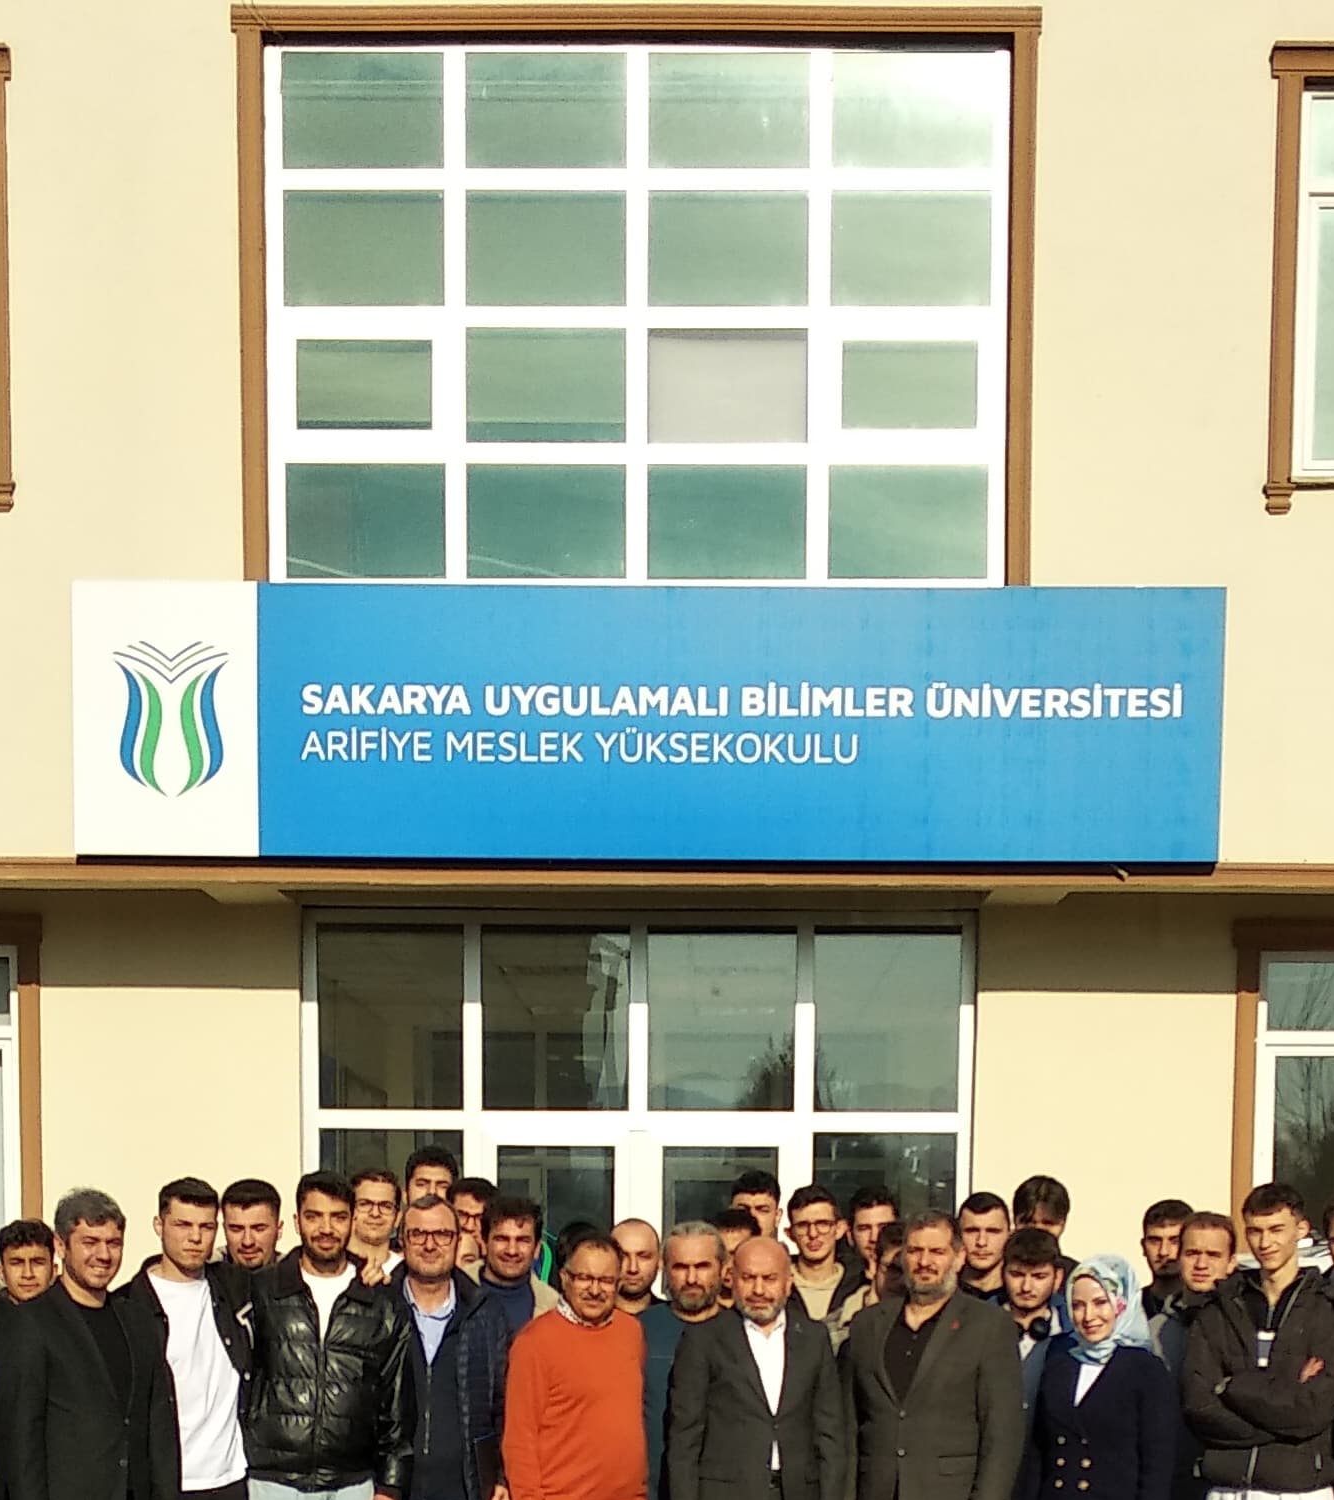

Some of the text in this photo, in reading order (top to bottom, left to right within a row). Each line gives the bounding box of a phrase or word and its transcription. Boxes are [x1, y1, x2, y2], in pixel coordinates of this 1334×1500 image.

[302, 681, 1183, 719] SAKARYA UYGULAMALI BİLİMLER ÜNİVERSİTESİ
[301, 726, 858, 764] ARİFİYE MESLEK YÜKSEKOKULU
